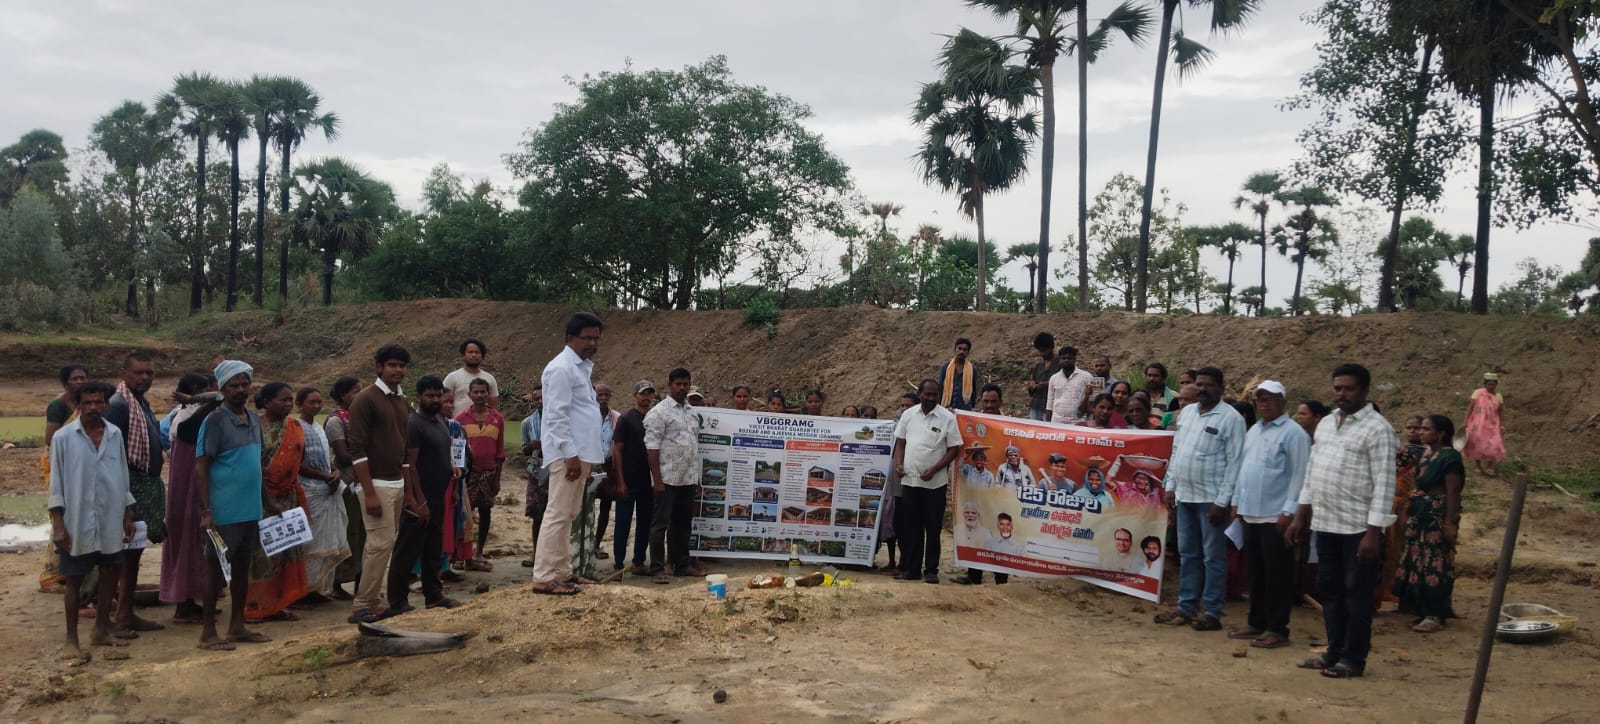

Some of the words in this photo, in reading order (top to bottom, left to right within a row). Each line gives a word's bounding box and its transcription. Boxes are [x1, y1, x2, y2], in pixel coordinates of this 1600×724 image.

[757, 417, 814, 428] VBGGRAMG
[1016, 486, 1046, 504] 125
[1047, 488, 1100, 512] రోజుల
